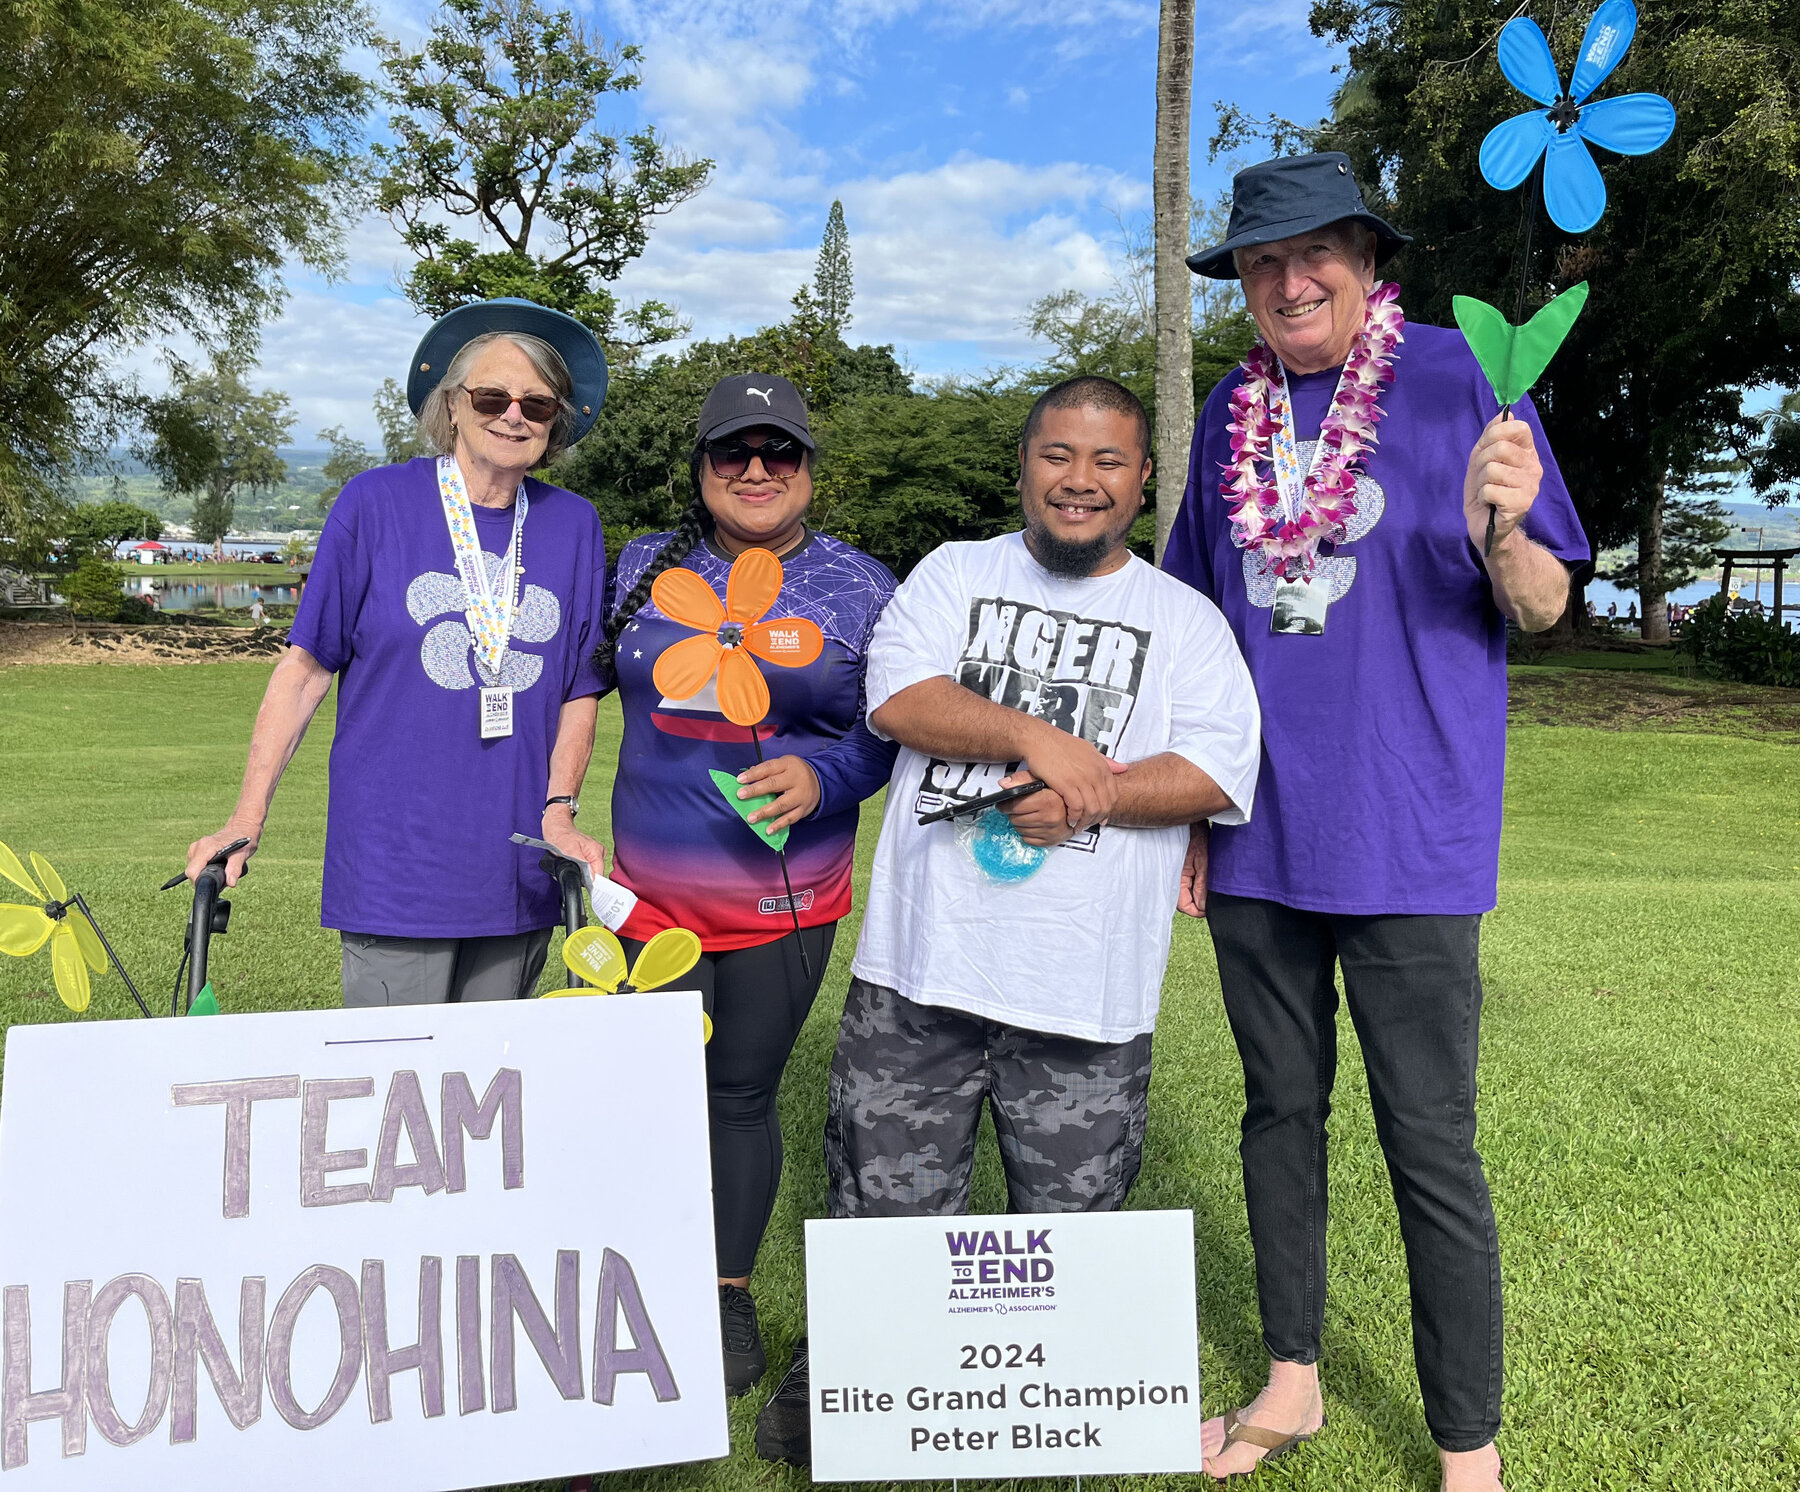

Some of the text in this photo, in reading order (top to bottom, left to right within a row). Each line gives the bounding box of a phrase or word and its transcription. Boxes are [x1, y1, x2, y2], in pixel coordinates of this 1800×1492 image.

[1585, 24, 1607, 62] WALK
[1597, 26, 1612, 55] END
[466, 576, 475, 594] WALK
[769, 630, 799, 638] WALK
[778, 637, 800, 646] END
[485, 693, 508, 703] WALK
[492, 702, 508, 712] END
[580, 949, 602, 973] WALK
[586, 943, 605, 960] END
[170, 1067, 524, 1219] TEAM
[945, 1228, 1054, 1256] WALK
[953, 1257, 1055, 1284] TO END
[948, 1286, 1056, 1300] ALZHEIMER'S
[948, 1305, 994, 1314] ALZHEIMER'S
[2, 1246, 681, 1470] HONOHINA
[959, 1343, 1047, 1370] 2024
[820, 1379, 1190, 1414] Elite Grand Champion
[910, 1422, 1103, 1453] Peter Black
